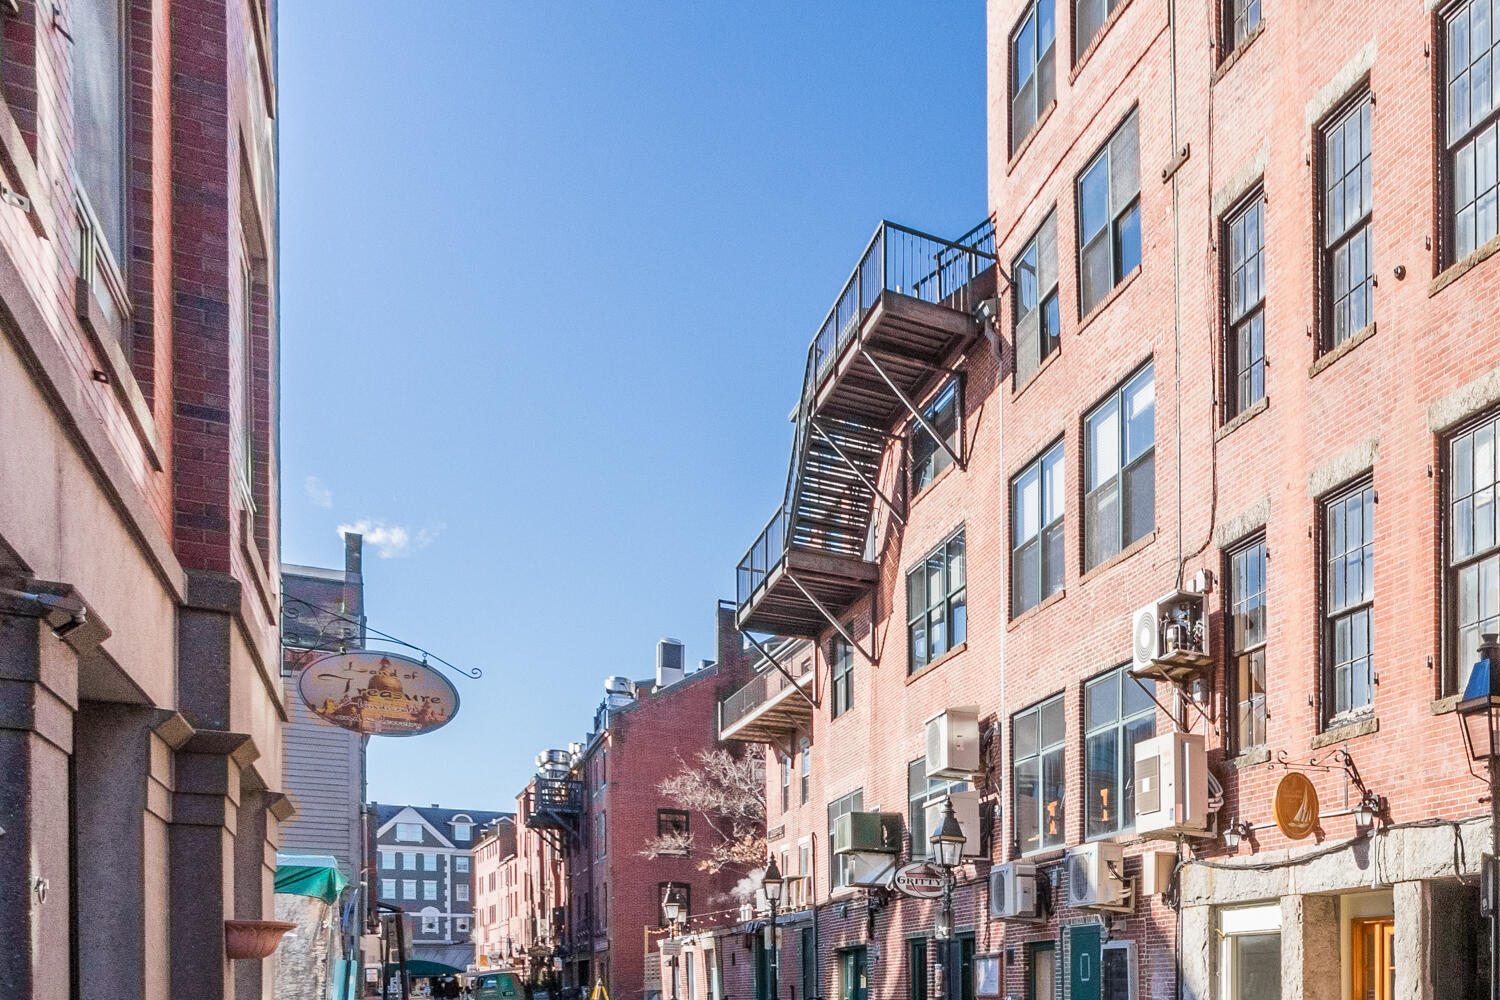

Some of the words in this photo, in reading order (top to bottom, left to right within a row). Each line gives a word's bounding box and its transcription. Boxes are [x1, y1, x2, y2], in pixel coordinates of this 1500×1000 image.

[344, 661, 398, 678] Land
[404, 671, 417, 680] of
[317, 673, 441, 704] Treasure
[335, 714, 362, 722] and
